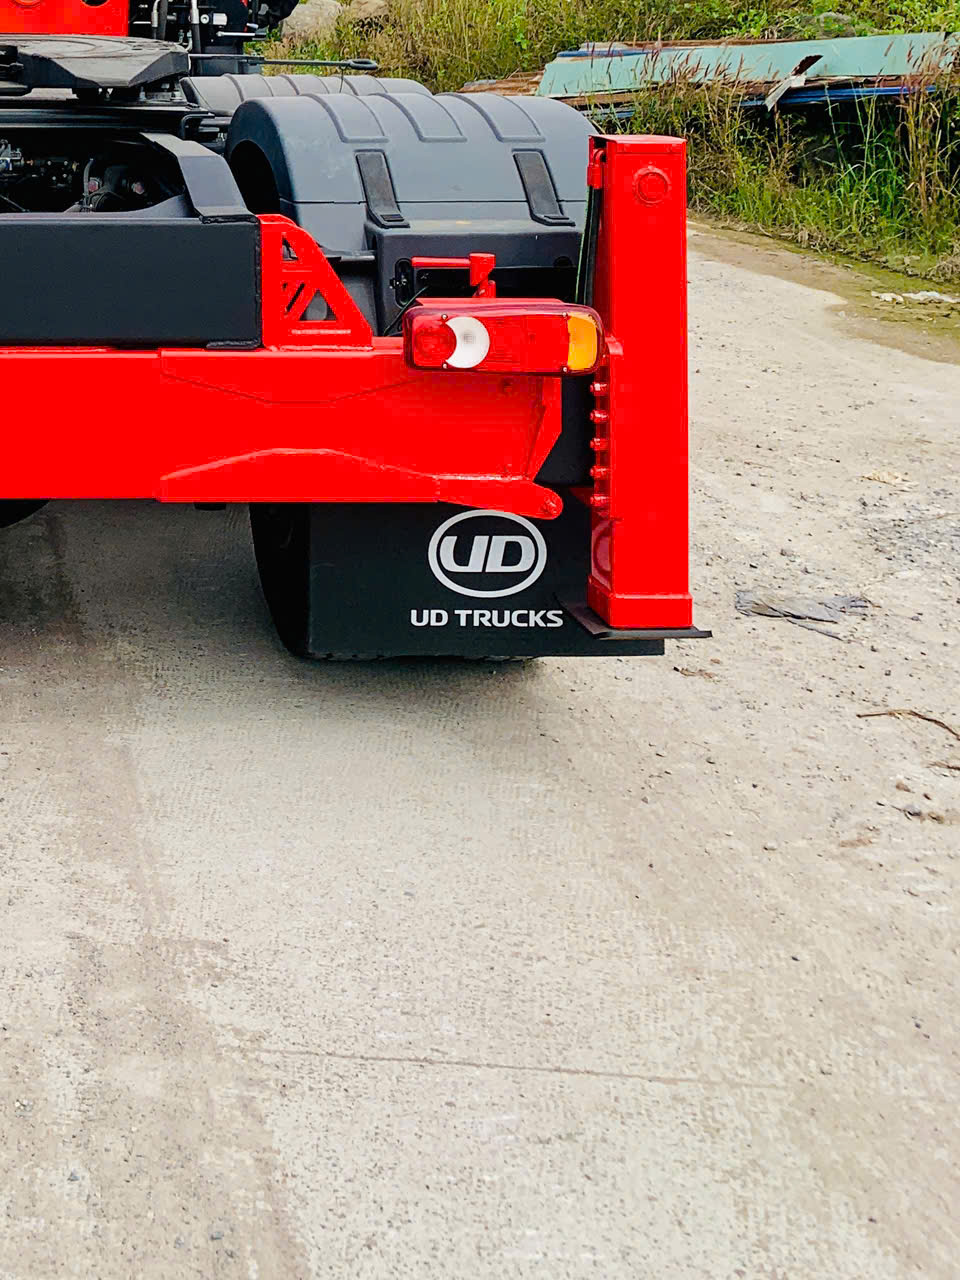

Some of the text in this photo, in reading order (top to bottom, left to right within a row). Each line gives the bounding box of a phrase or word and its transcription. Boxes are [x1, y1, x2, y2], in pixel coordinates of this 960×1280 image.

[439, 535, 536, 573] UD
[410, 609, 564, 628] UD TRUCKS
